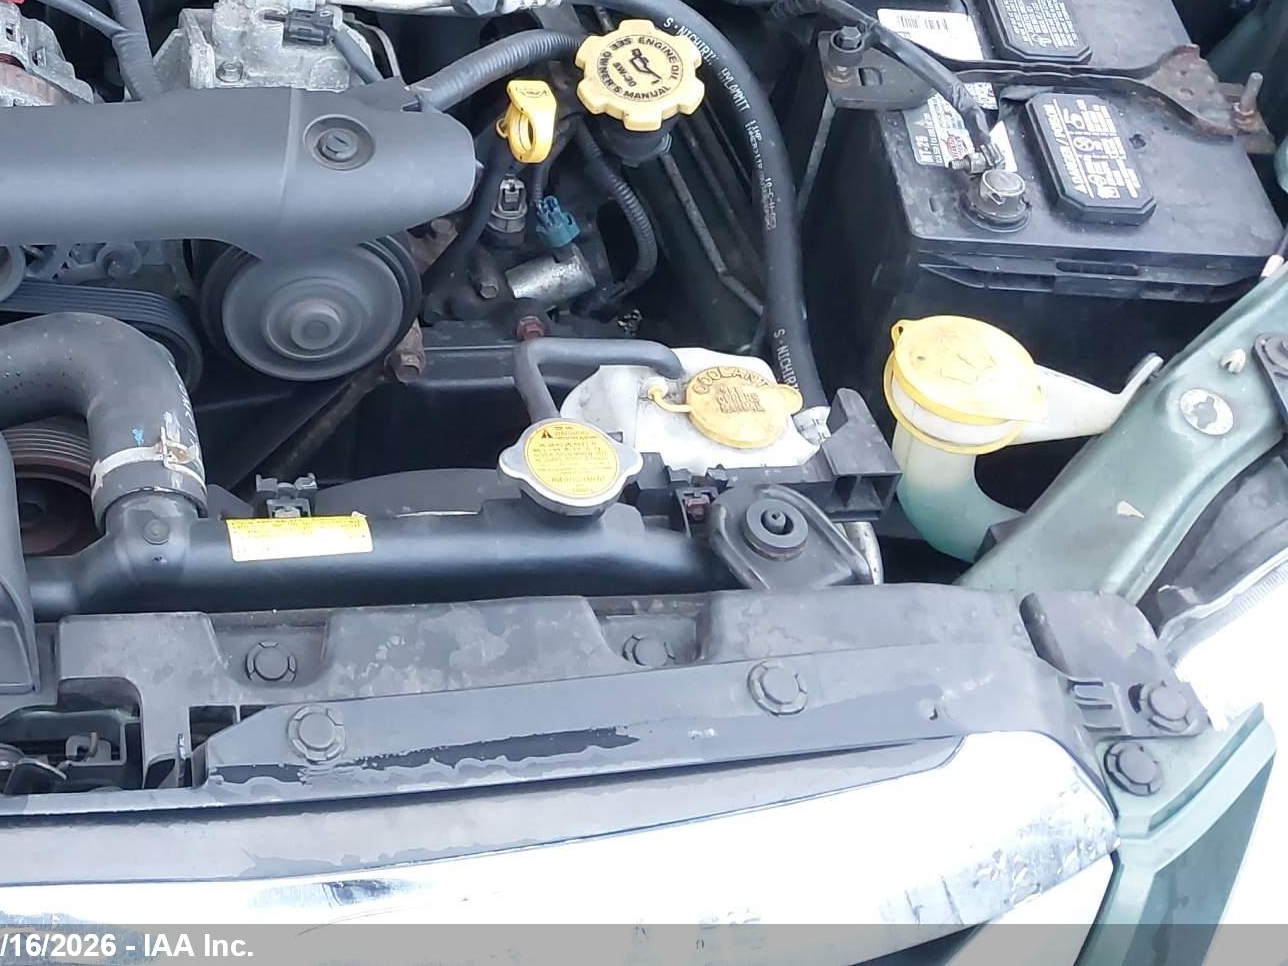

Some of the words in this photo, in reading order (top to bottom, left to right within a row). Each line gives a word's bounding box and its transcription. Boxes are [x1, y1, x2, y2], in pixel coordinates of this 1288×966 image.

[638, 36, 678, 64] ENGINE
[668, 64, 681, 81] OIL
[622, 84, 672, 100] MANUAL
[692, 366, 770, 395] COOLANT
